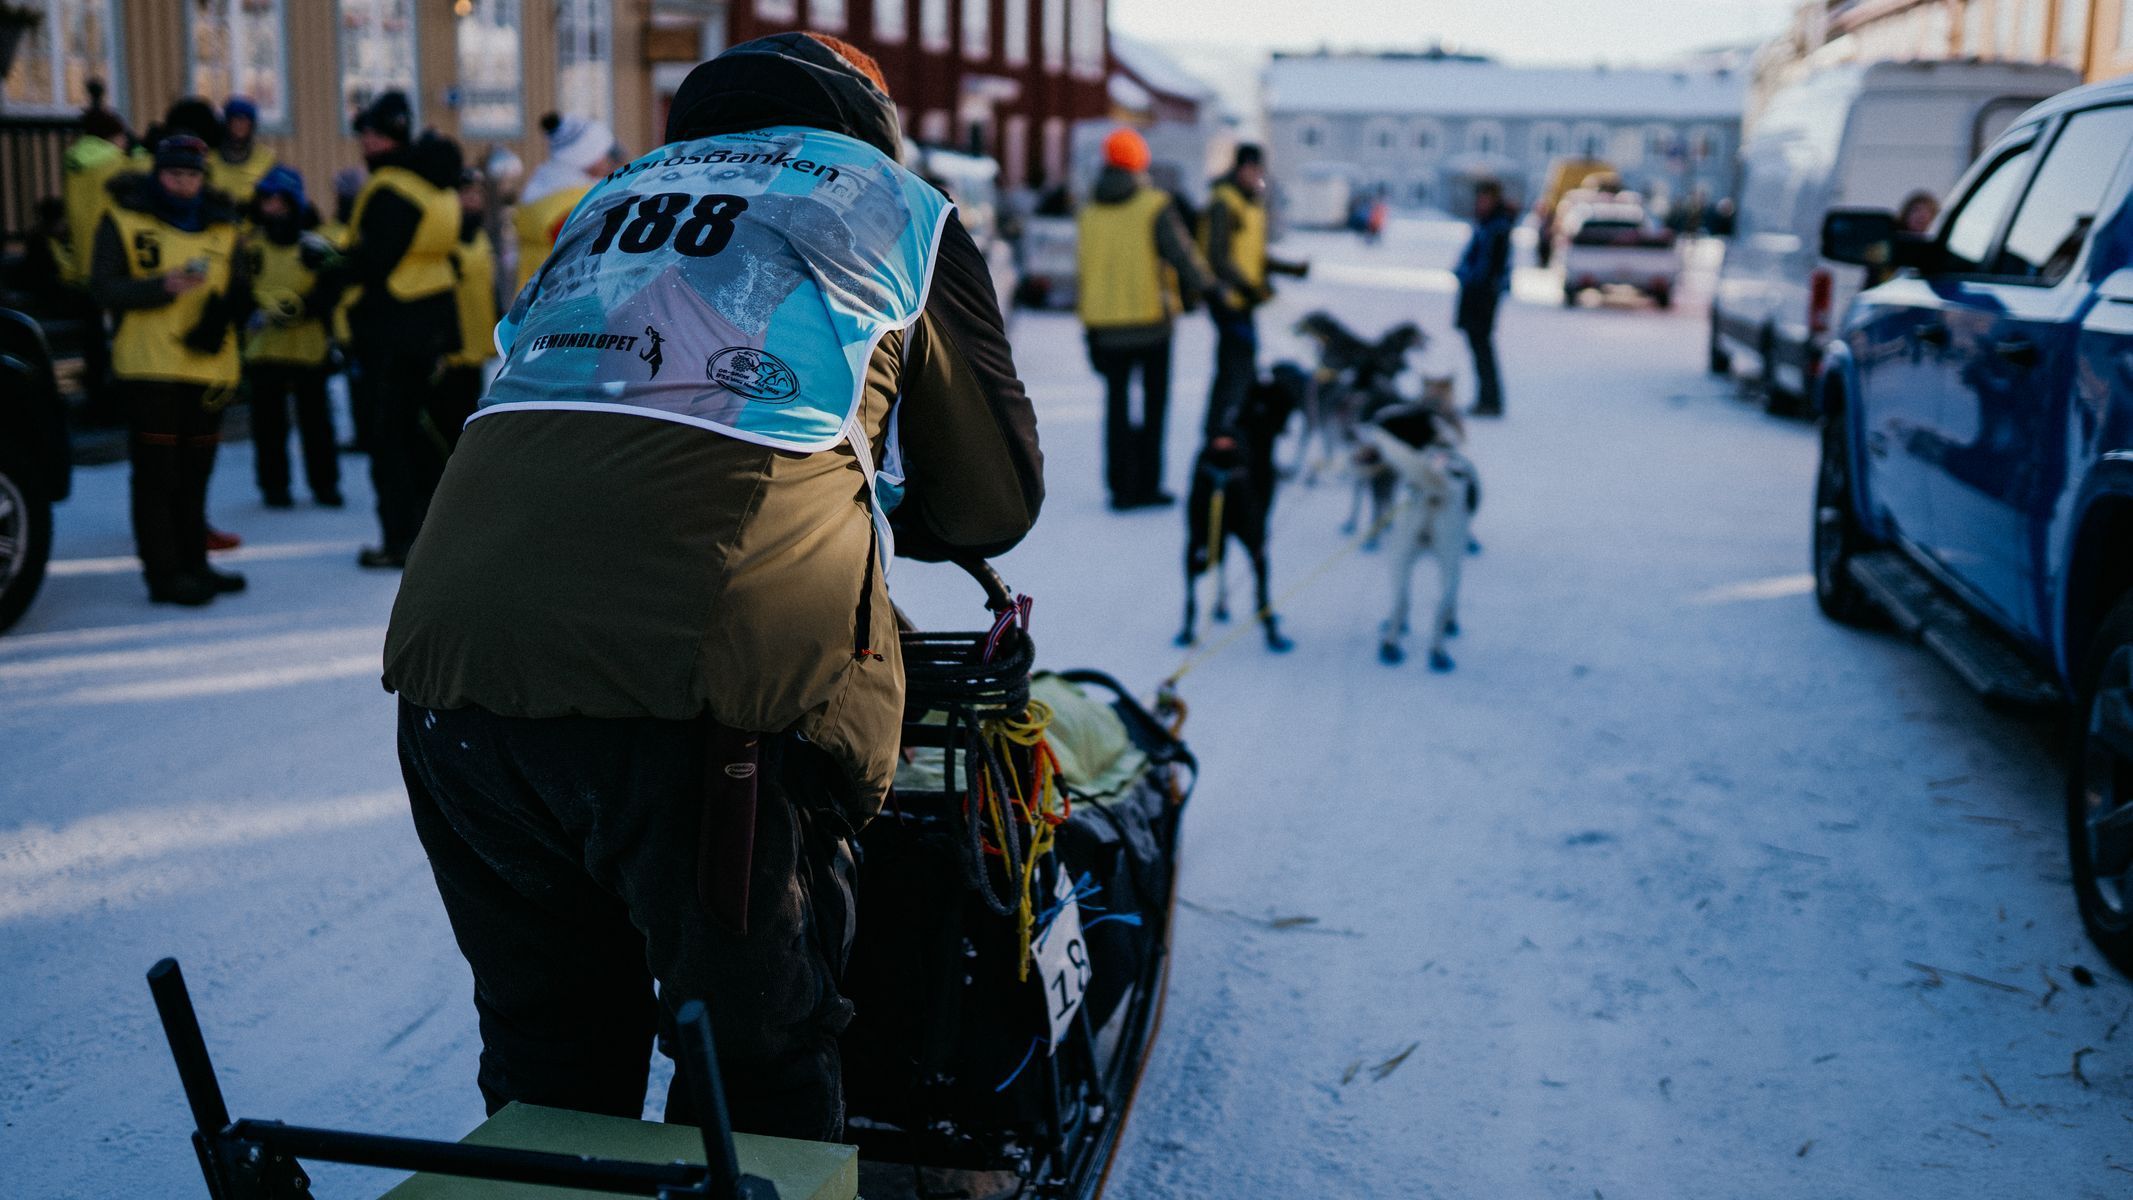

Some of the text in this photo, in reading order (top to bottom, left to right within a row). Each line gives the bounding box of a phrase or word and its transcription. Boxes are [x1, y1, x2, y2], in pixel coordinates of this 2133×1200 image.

[588, 192, 750, 258] 188
[135, 229, 161, 270] 5
[532, 332, 639, 352] FEMUNDLØPET
